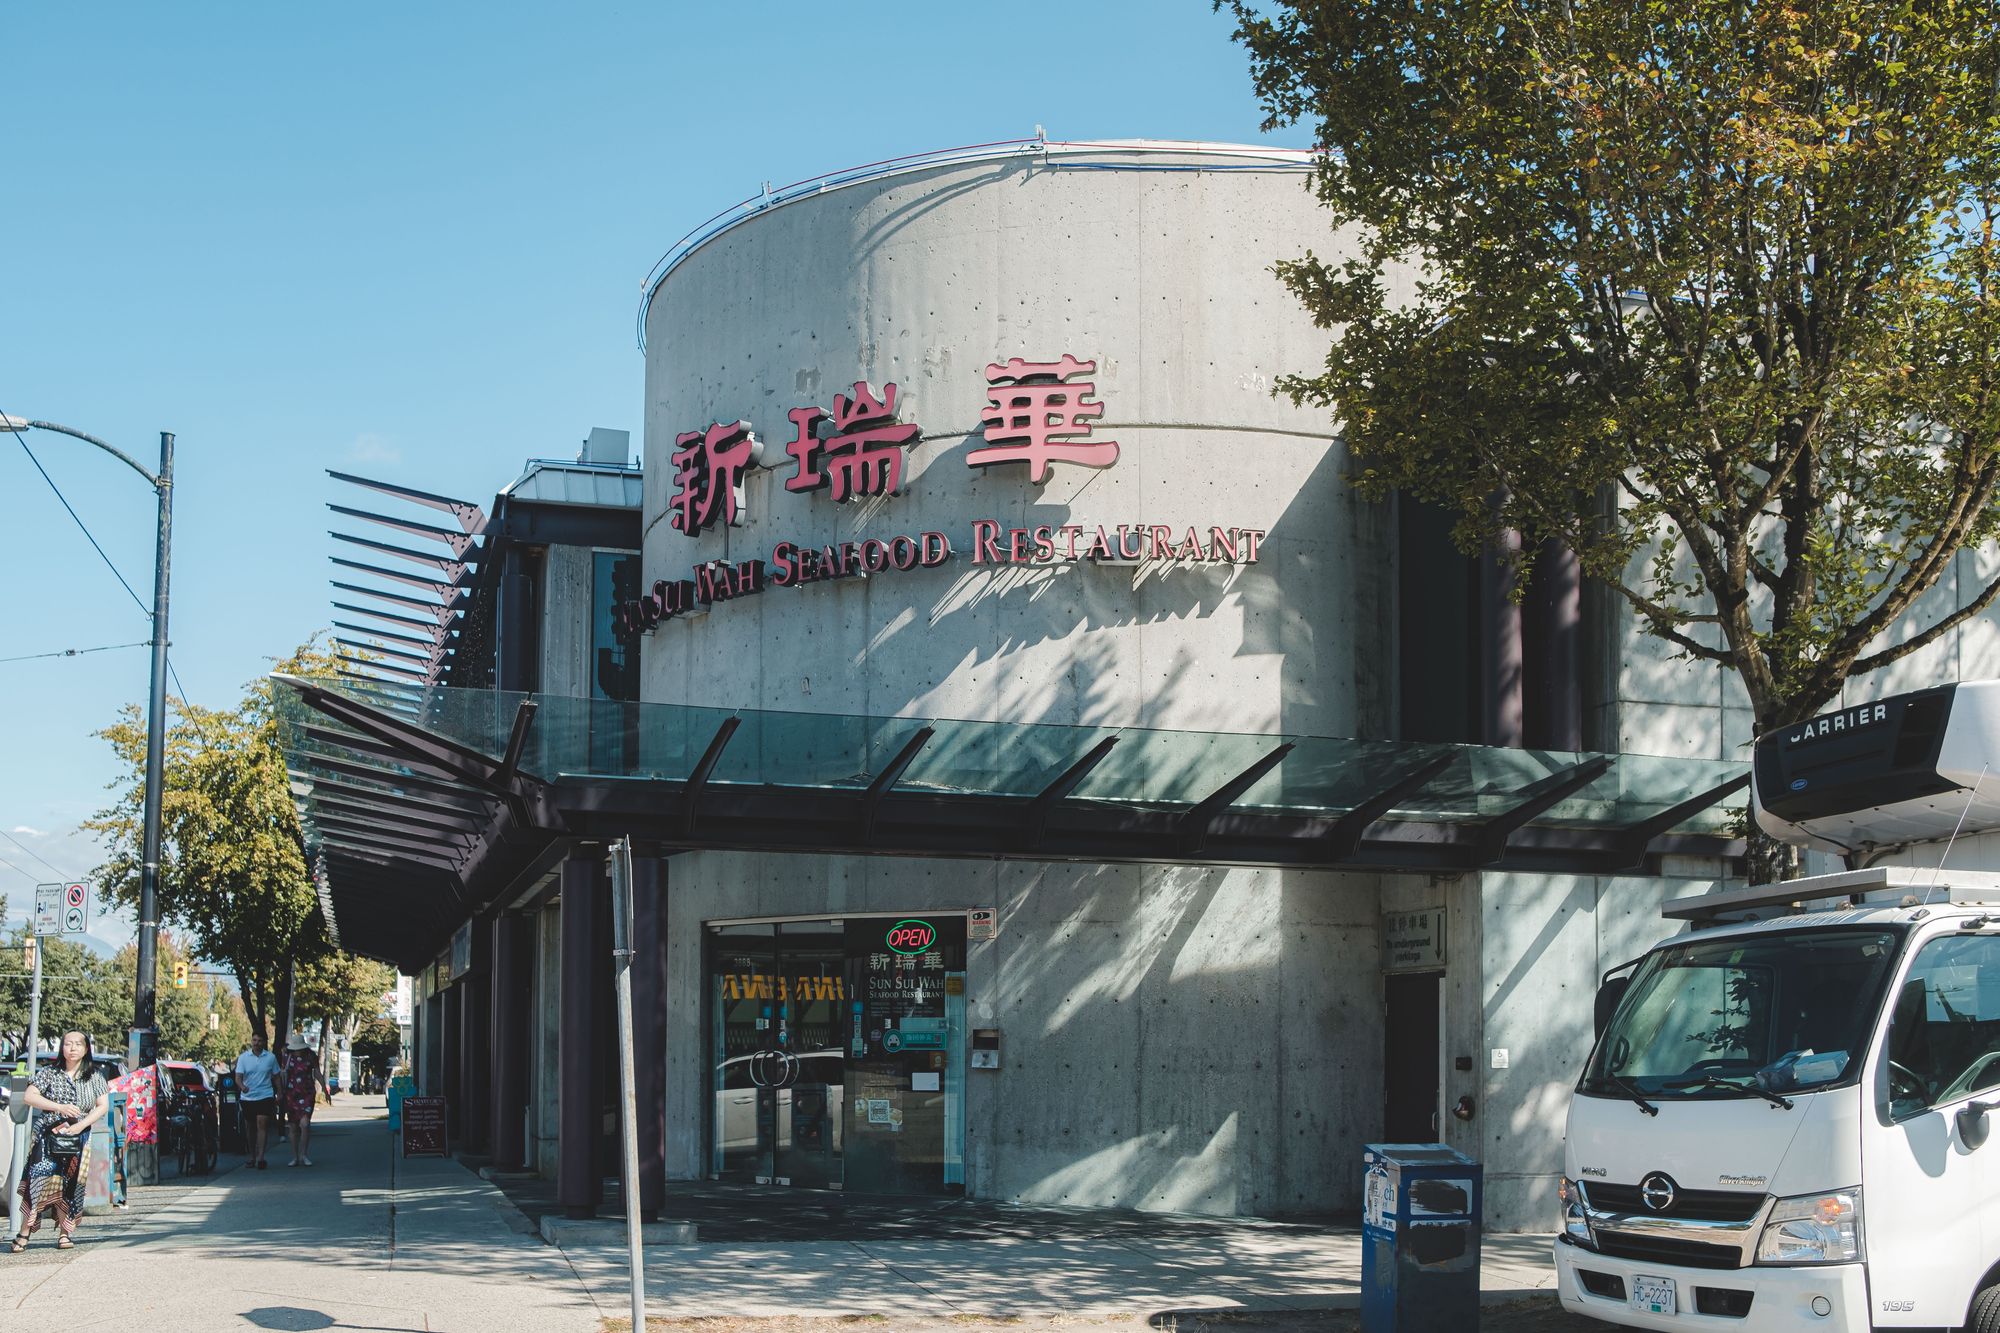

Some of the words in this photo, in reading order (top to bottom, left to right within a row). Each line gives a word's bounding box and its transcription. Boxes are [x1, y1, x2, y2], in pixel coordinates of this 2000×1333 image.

[972, 519, 1266, 566] RESTAURANT
[889, 928, 932, 946] OPEN
[1394, 936, 1431, 950] underground
[869, 952, 945, 971] 新瑞華
[1882, 1300, 1915, 1312] 195
